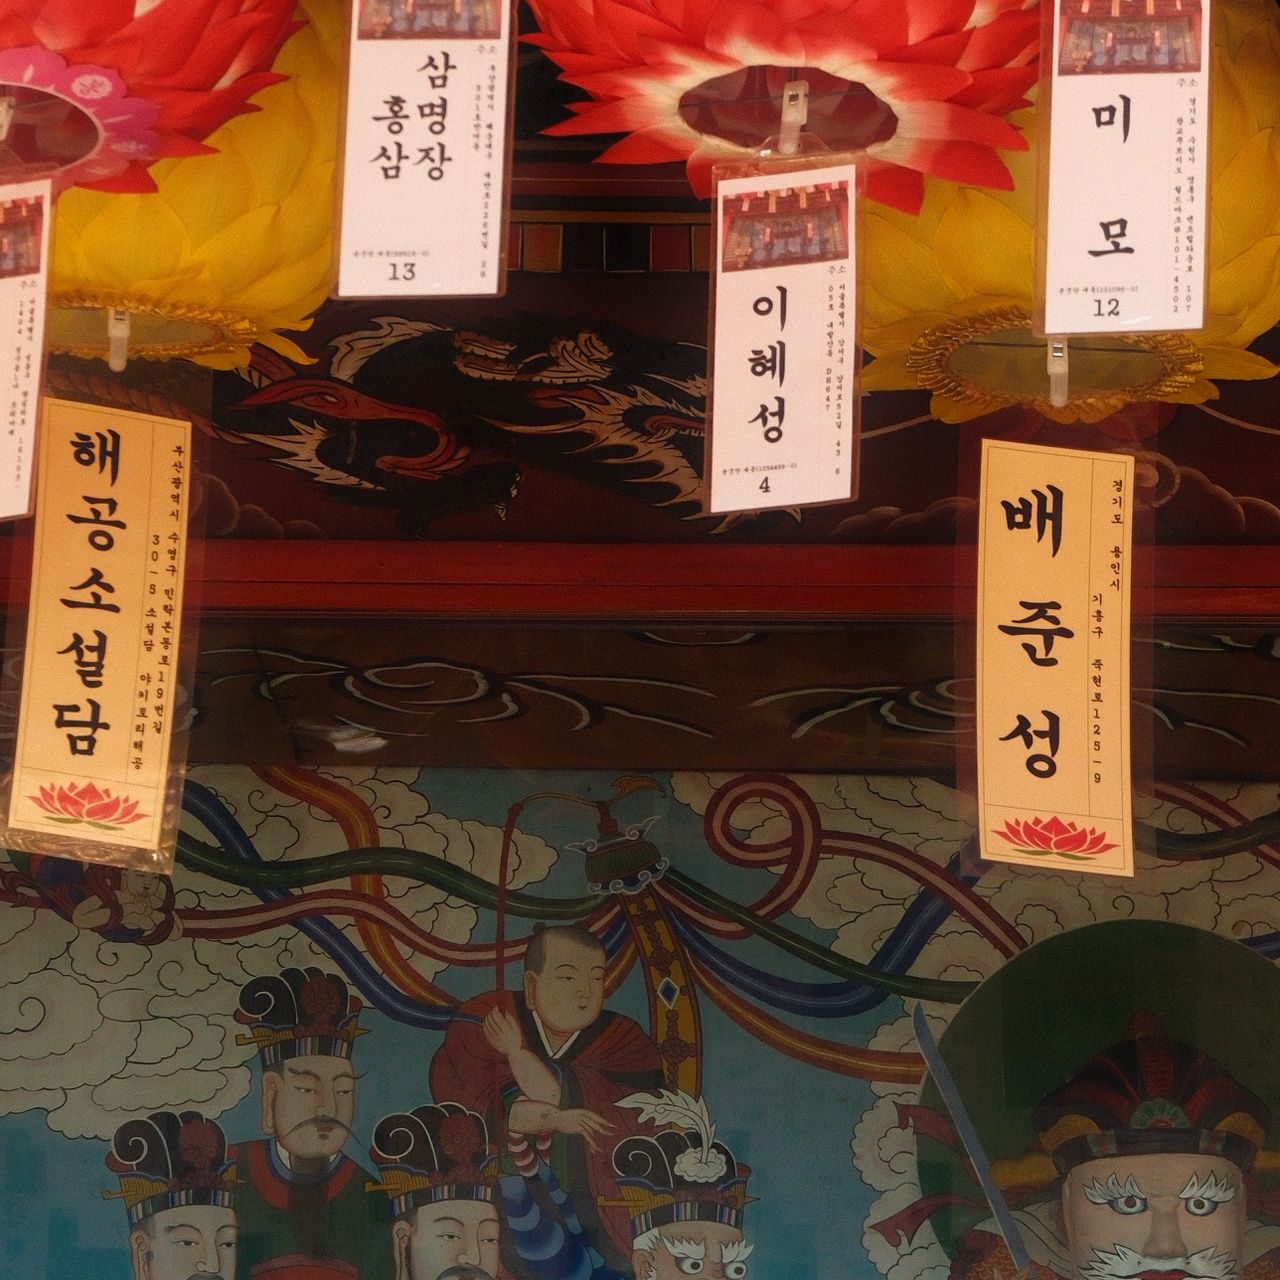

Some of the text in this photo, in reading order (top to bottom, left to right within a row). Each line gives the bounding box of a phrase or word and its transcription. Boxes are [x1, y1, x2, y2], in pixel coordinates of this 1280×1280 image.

[368, 95, 411, 181] 홍삼
[412, 50, 458, 182] 삼명장
[387, 262, 417, 281] 13
[1092, 297, 1122, 317] 12
[747, 285, 788, 444] 이혜성
[169, 445, 184, 522] 부산광역시
[758, 476, 772, 494] 4
[164, 531, 180, 575] 수영구
[1109, 479, 1124, 592] 경기도 용인시
[54, 428, 128, 757] 해공소설담
[142, 606, 157, 653] 소설담
[998, 483, 1076, 779] 배준성
[1091, 593, 1104, 640] 기흥구
